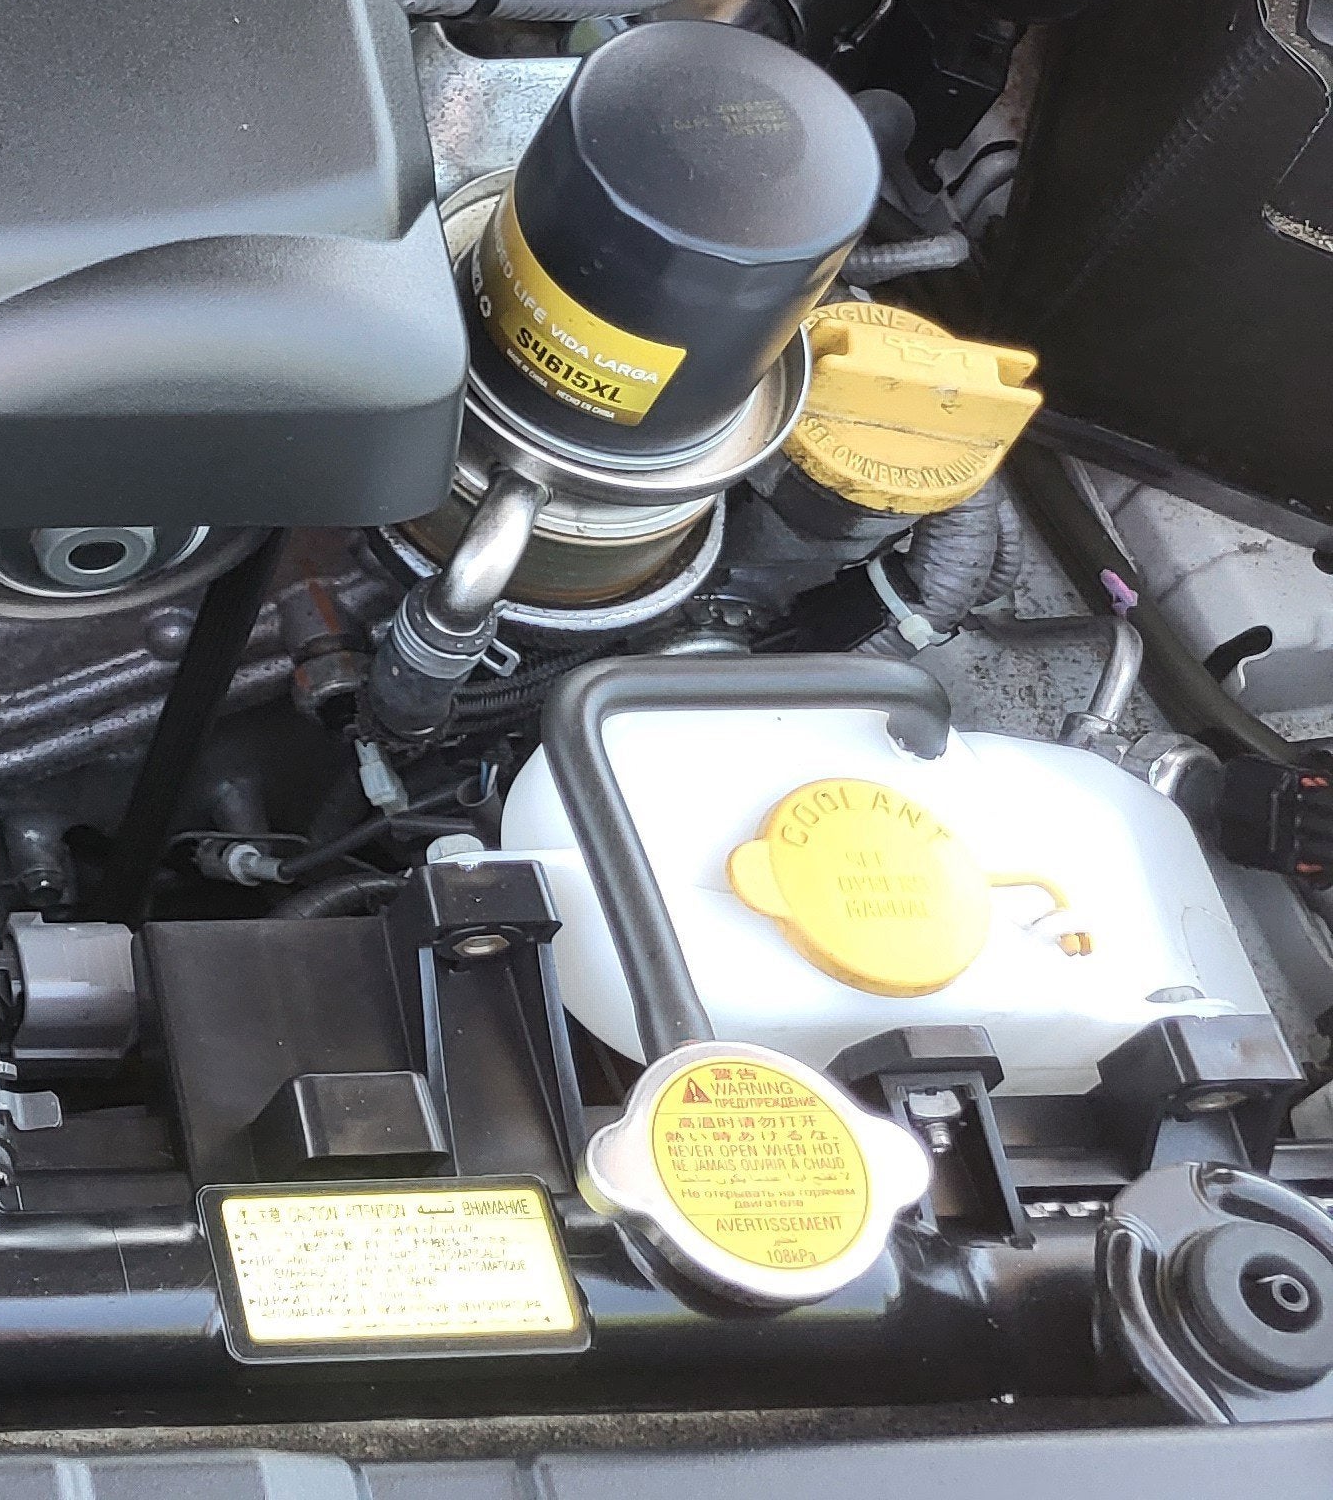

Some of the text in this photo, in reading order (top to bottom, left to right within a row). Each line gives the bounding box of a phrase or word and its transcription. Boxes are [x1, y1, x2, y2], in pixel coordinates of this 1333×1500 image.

[514, 280, 658, 384] LIFE VIDA LARGA
[516, 327, 623, 404] S4615XL
[833, 445, 920, 488] OWNER'S
[921, 450, 989, 489] MANUAL
[780, 786, 951, 848] COOLANT
[711, 1082, 793, 1096] WARNING
[714, 1097, 817, 1109] ПРЕДУПРЕЖДЕНИЕ
[668, 1143, 841, 1158] NEVER OPEN WHEN HOT
[672, 1160, 688, 1172] NE
[694, 1159, 736, 1171] JAMAIS
[741, 1158, 785, 1171] OUVRIR
[803, 1157, 845, 1170] CHAUD
[462, 1198, 530, 1217] ВНИМАНИЕ
[716, 1215, 843, 1232] AVERTISSEMENT
[767, 1249, 817, 1264] 108kPa
